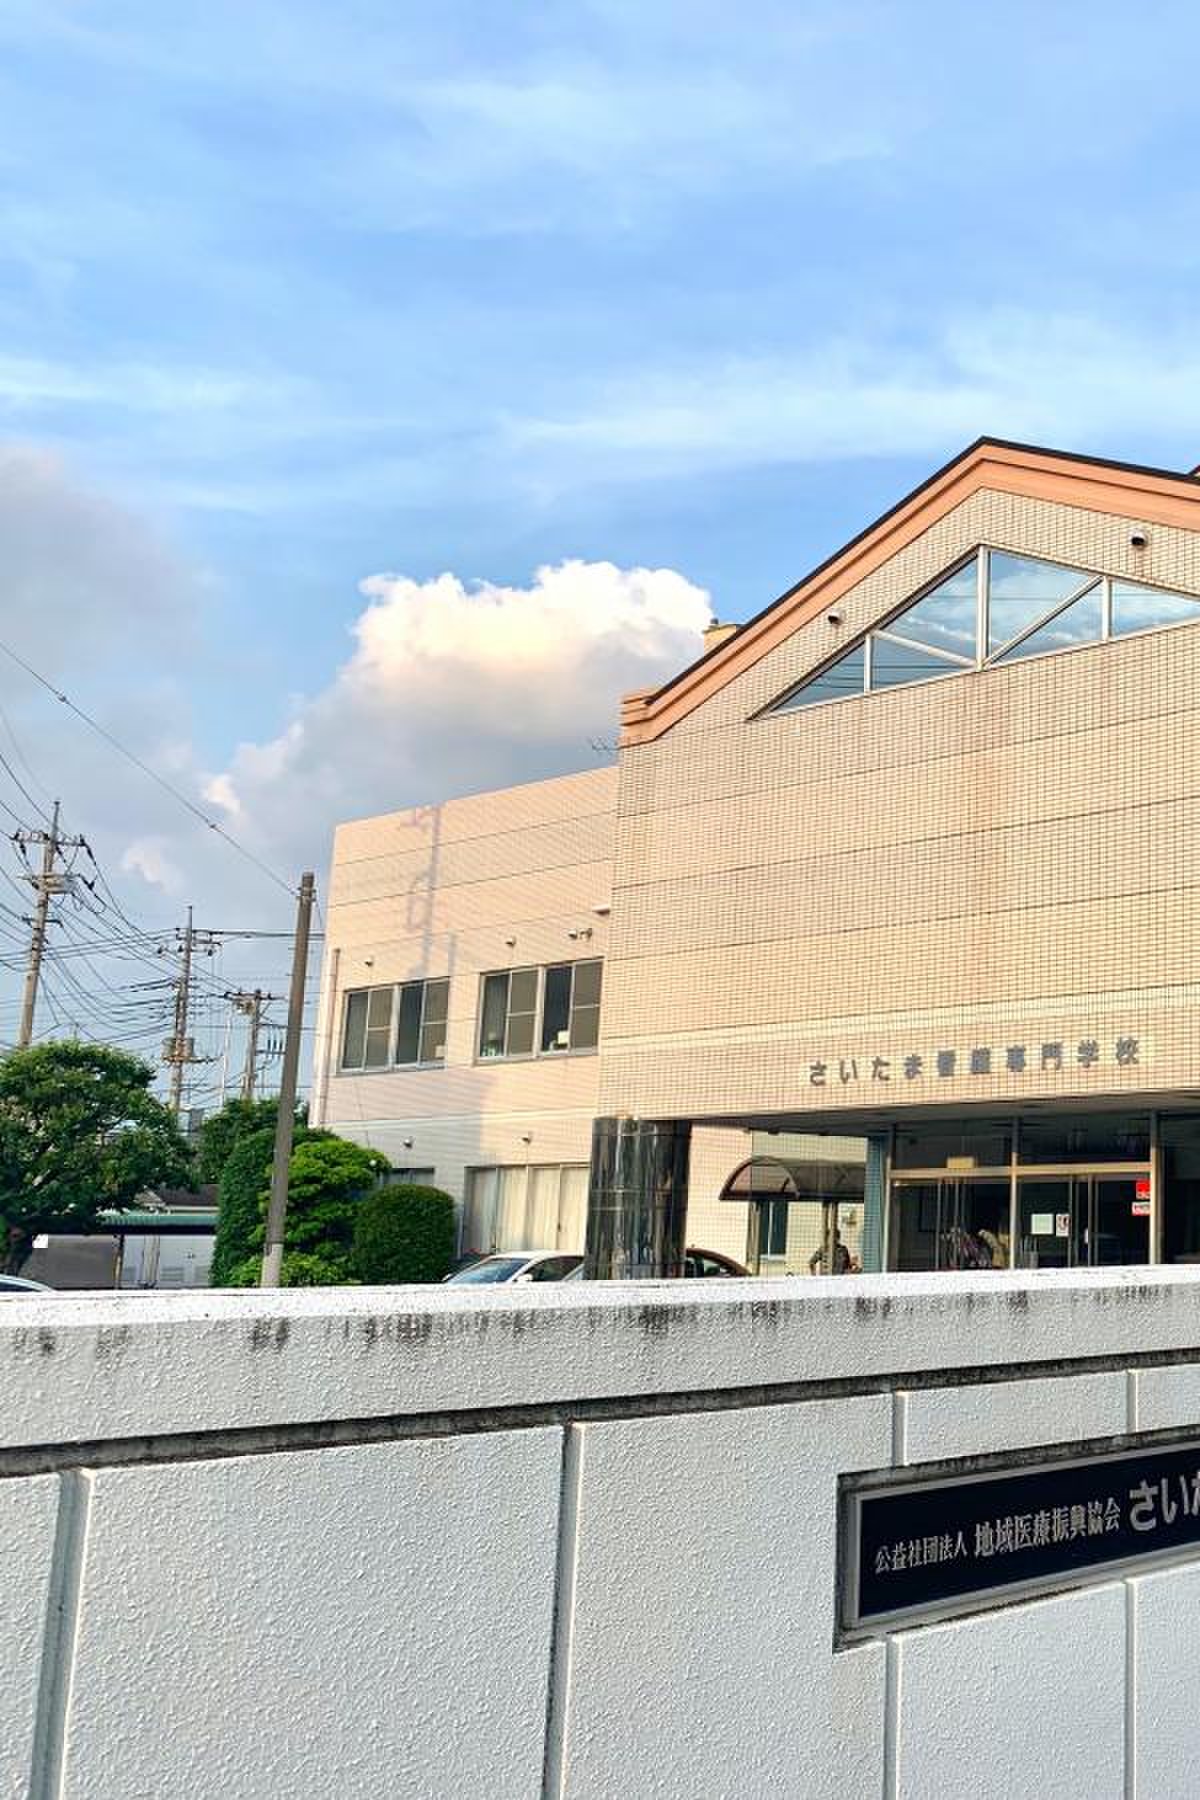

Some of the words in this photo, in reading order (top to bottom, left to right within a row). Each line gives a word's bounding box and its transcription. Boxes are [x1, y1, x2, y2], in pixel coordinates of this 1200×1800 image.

[875, 1531, 968, 1574] 公益社団法人
[975, 1497, 1121, 1557] 地域医療振興協会
